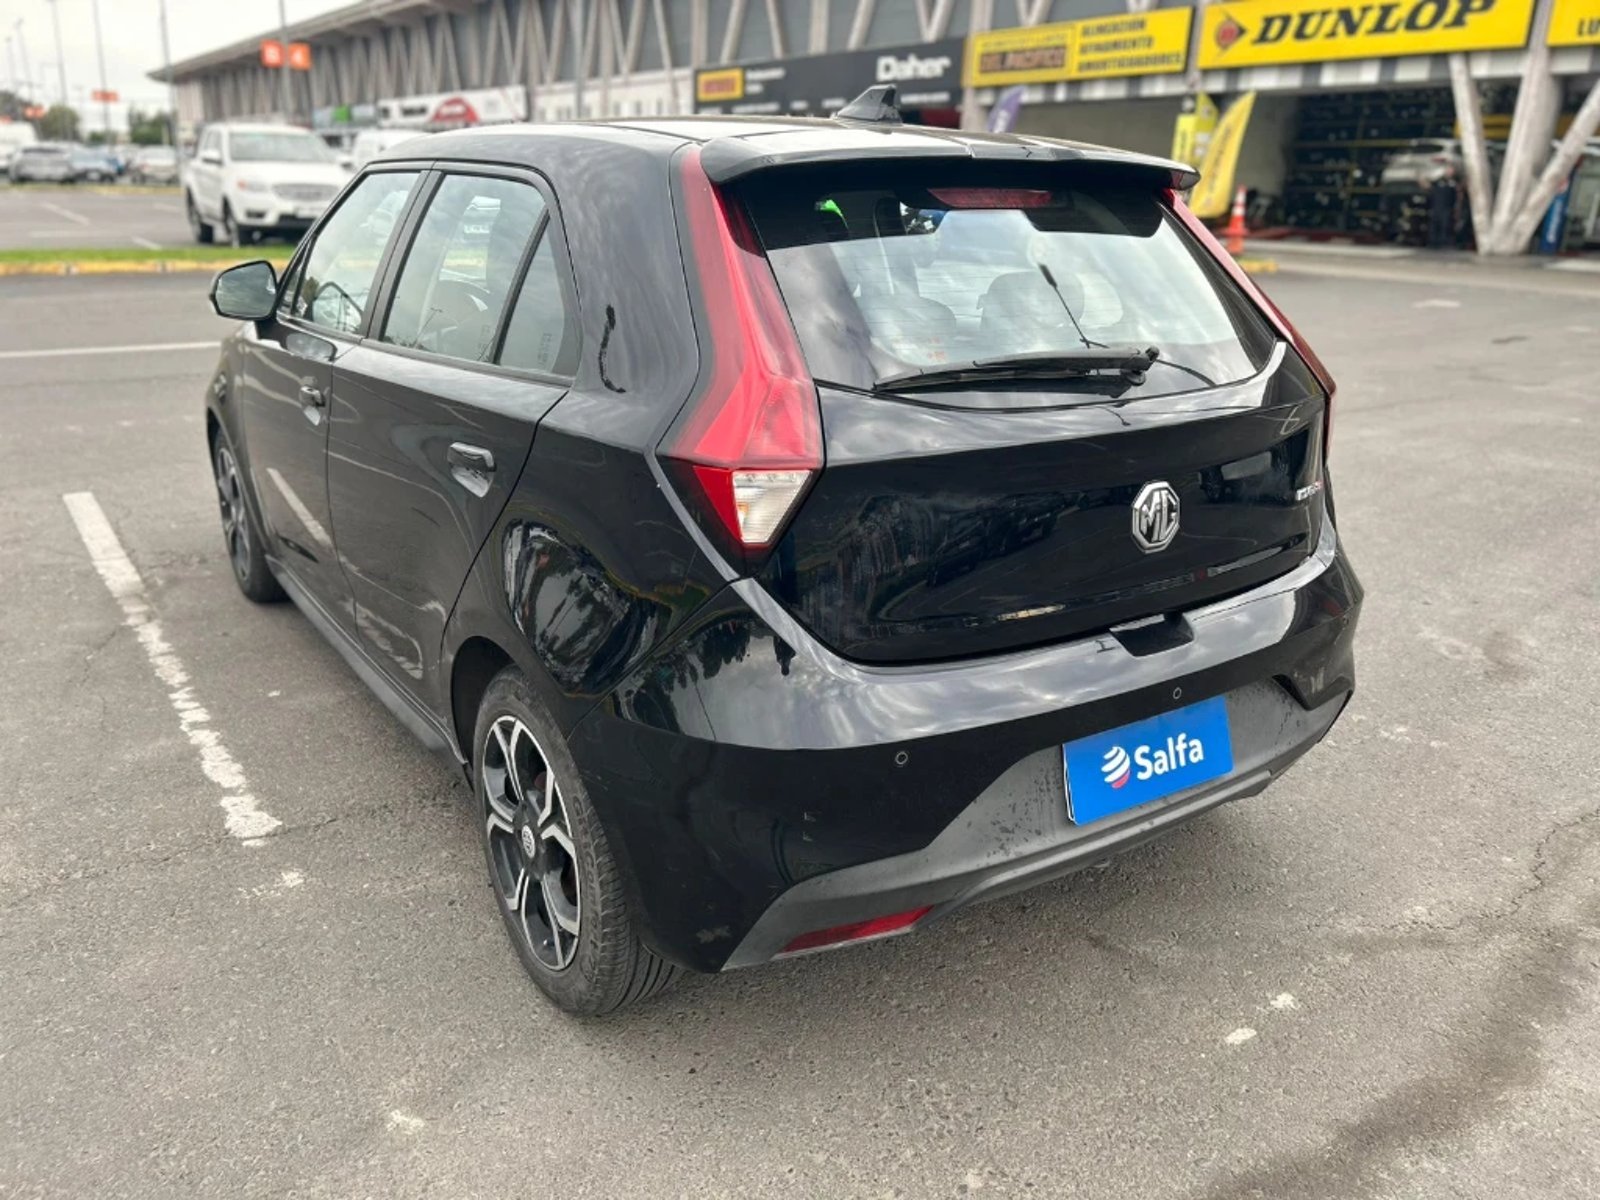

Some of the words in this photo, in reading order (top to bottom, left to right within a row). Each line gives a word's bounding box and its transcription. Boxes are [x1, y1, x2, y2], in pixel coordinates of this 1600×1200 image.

[1251, 0, 1497, 45] DUNLOP
[876, 53, 952, 81] Daher
[1138, 487, 1178, 545] MG
[1134, 732, 1204, 780] Salfa
